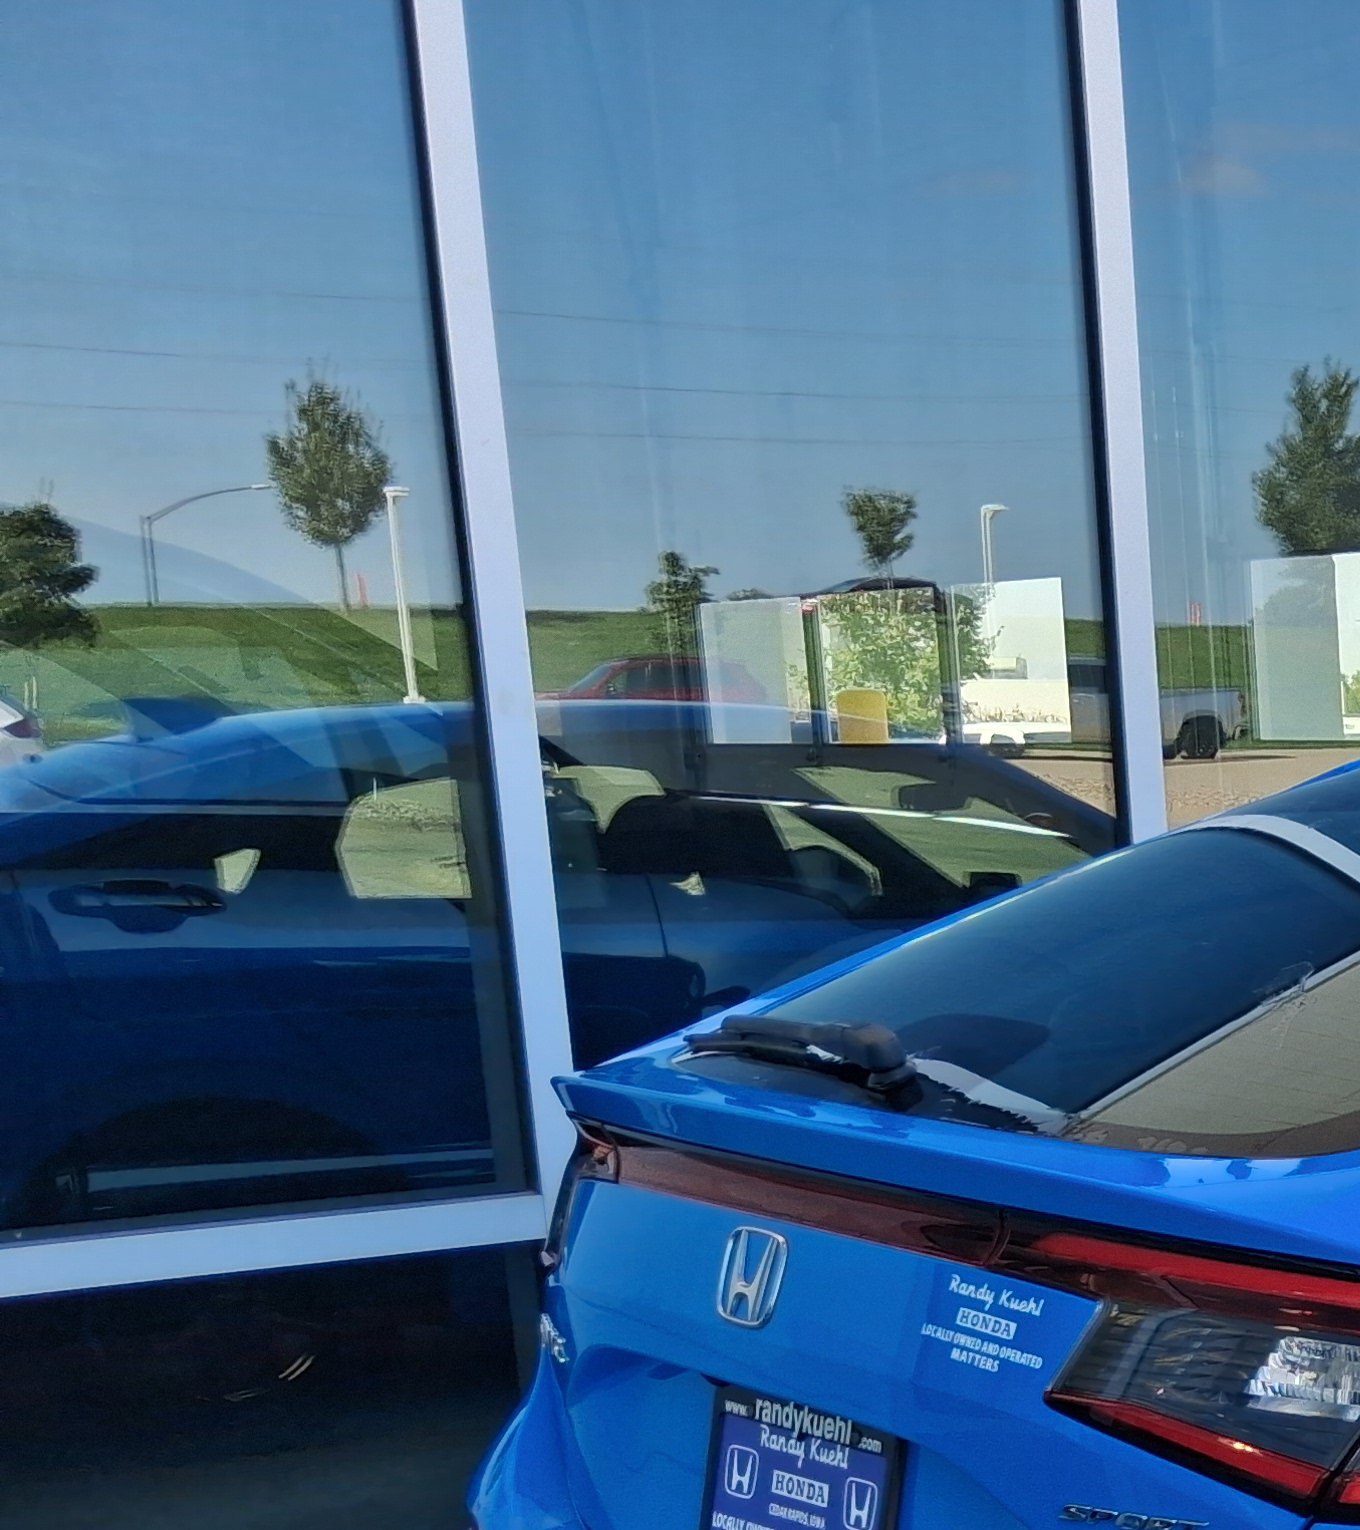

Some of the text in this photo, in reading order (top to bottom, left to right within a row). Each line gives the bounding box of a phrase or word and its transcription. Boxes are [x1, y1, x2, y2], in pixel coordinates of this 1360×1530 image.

[949, 1274, 1044, 1316] Randy Kuehl
[960, 1309, 1012, 1337] HONDA
[921, 1322, 1043, 1369] LOCALLY OWNED AND OPERATED
[950, 1347, 999, 1372] MATTERS
[760, 1424, 850, 1469] Randy Kuehl
[774, 1473, 825, 1503] HONDA
